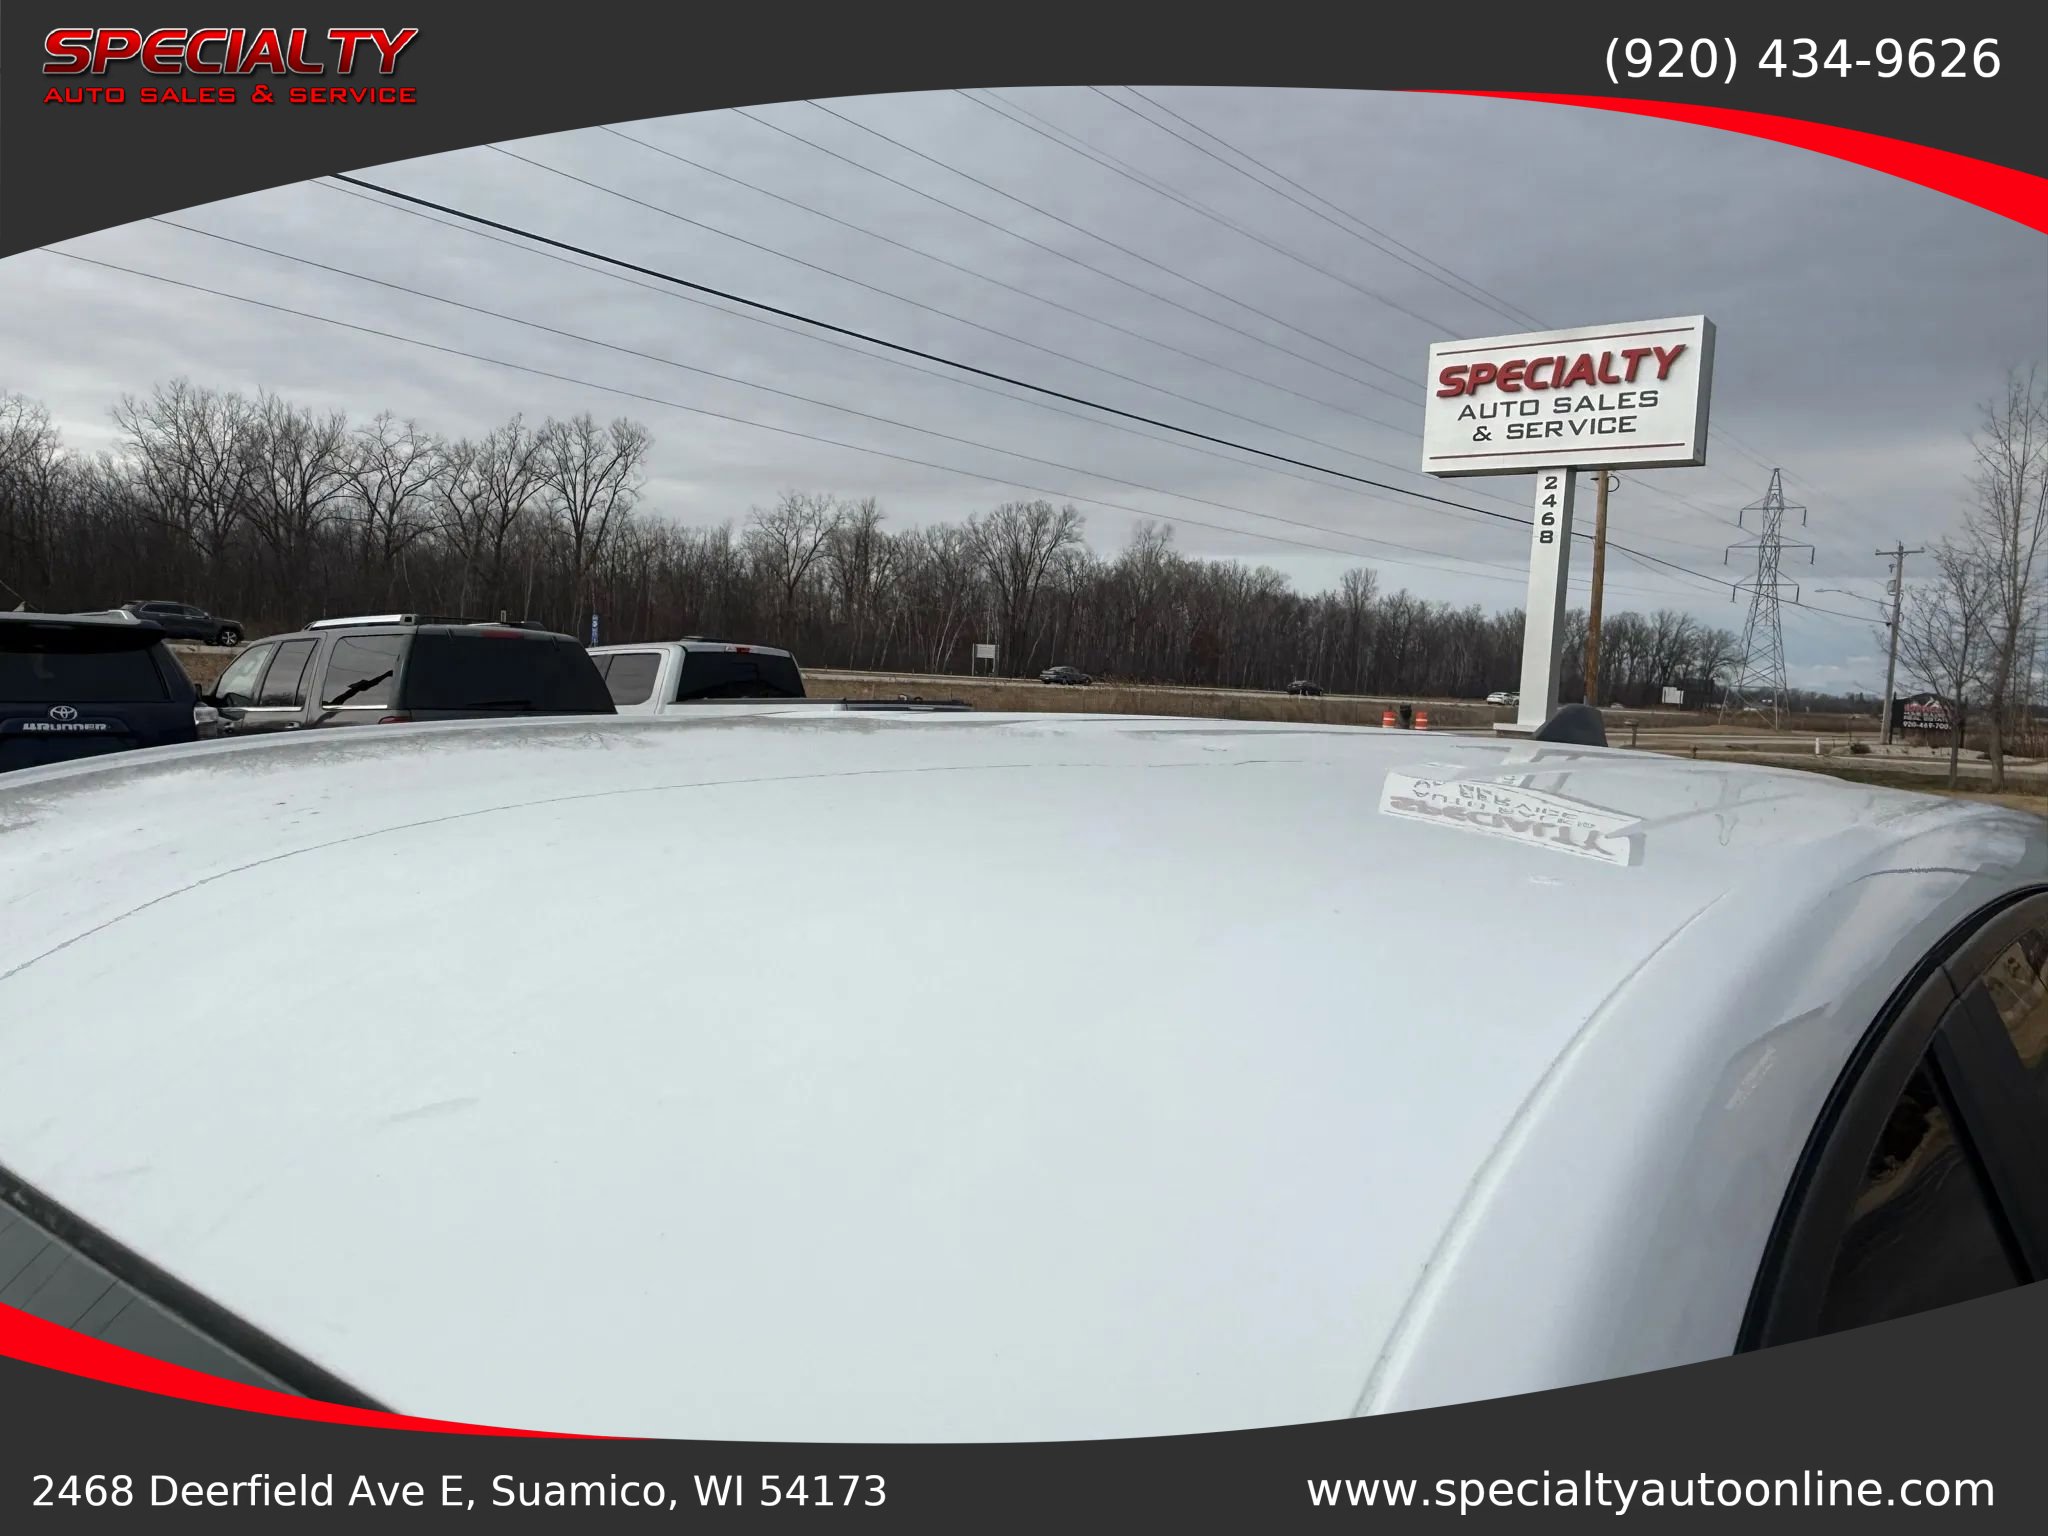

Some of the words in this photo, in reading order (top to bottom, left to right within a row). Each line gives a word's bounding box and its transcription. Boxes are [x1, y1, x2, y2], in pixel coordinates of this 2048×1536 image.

[1436, 343, 1688, 399] SPECIALTY
[1457, 399, 1540, 421] AUTO
[1552, 390, 1659, 414] SALES
[1472, 425, 1493, 442] &
[1505, 415, 1638, 440] SERVICE
[1539, 476, 1559, 544] 2468
[22, 722, 108, 731] 4RUNNER
